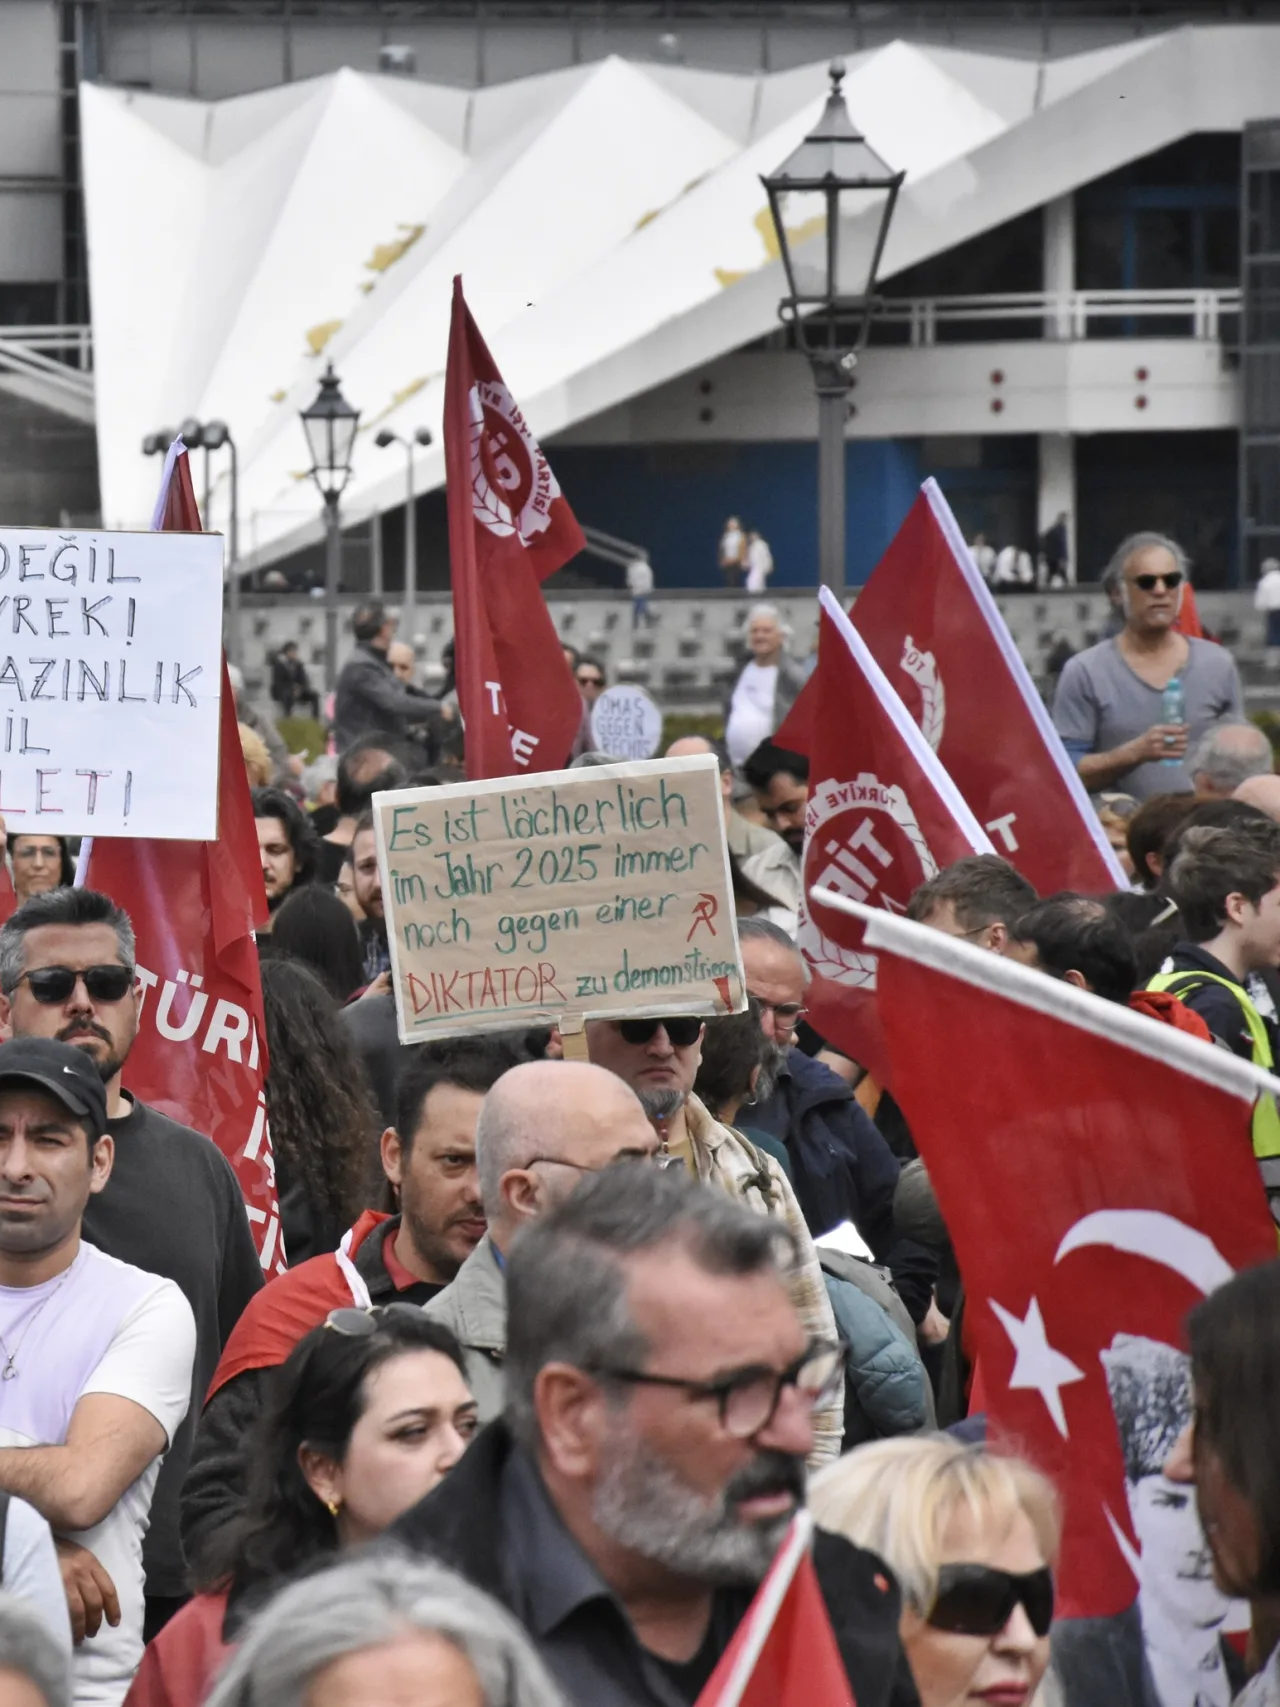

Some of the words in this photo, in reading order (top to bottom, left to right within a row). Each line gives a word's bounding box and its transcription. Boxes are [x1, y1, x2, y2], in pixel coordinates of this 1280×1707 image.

[389, 806, 433, 851] Es
[444, 799, 488, 845] ist
[501, 779, 688, 840] lächerlich
[391, 869, 427, 905] im
[434, 851, 504, 900] Jahr
[510, 844, 601, 888] 2025
[615, 843, 710, 877] immer
[404, 908, 470, 951] noch
[494, 908, 579, 954] gegen
[596, 893, 680, 924] einer
[405, 962, 568, 1015] DIKTATOR
[575, 973, 609, 998] zu
